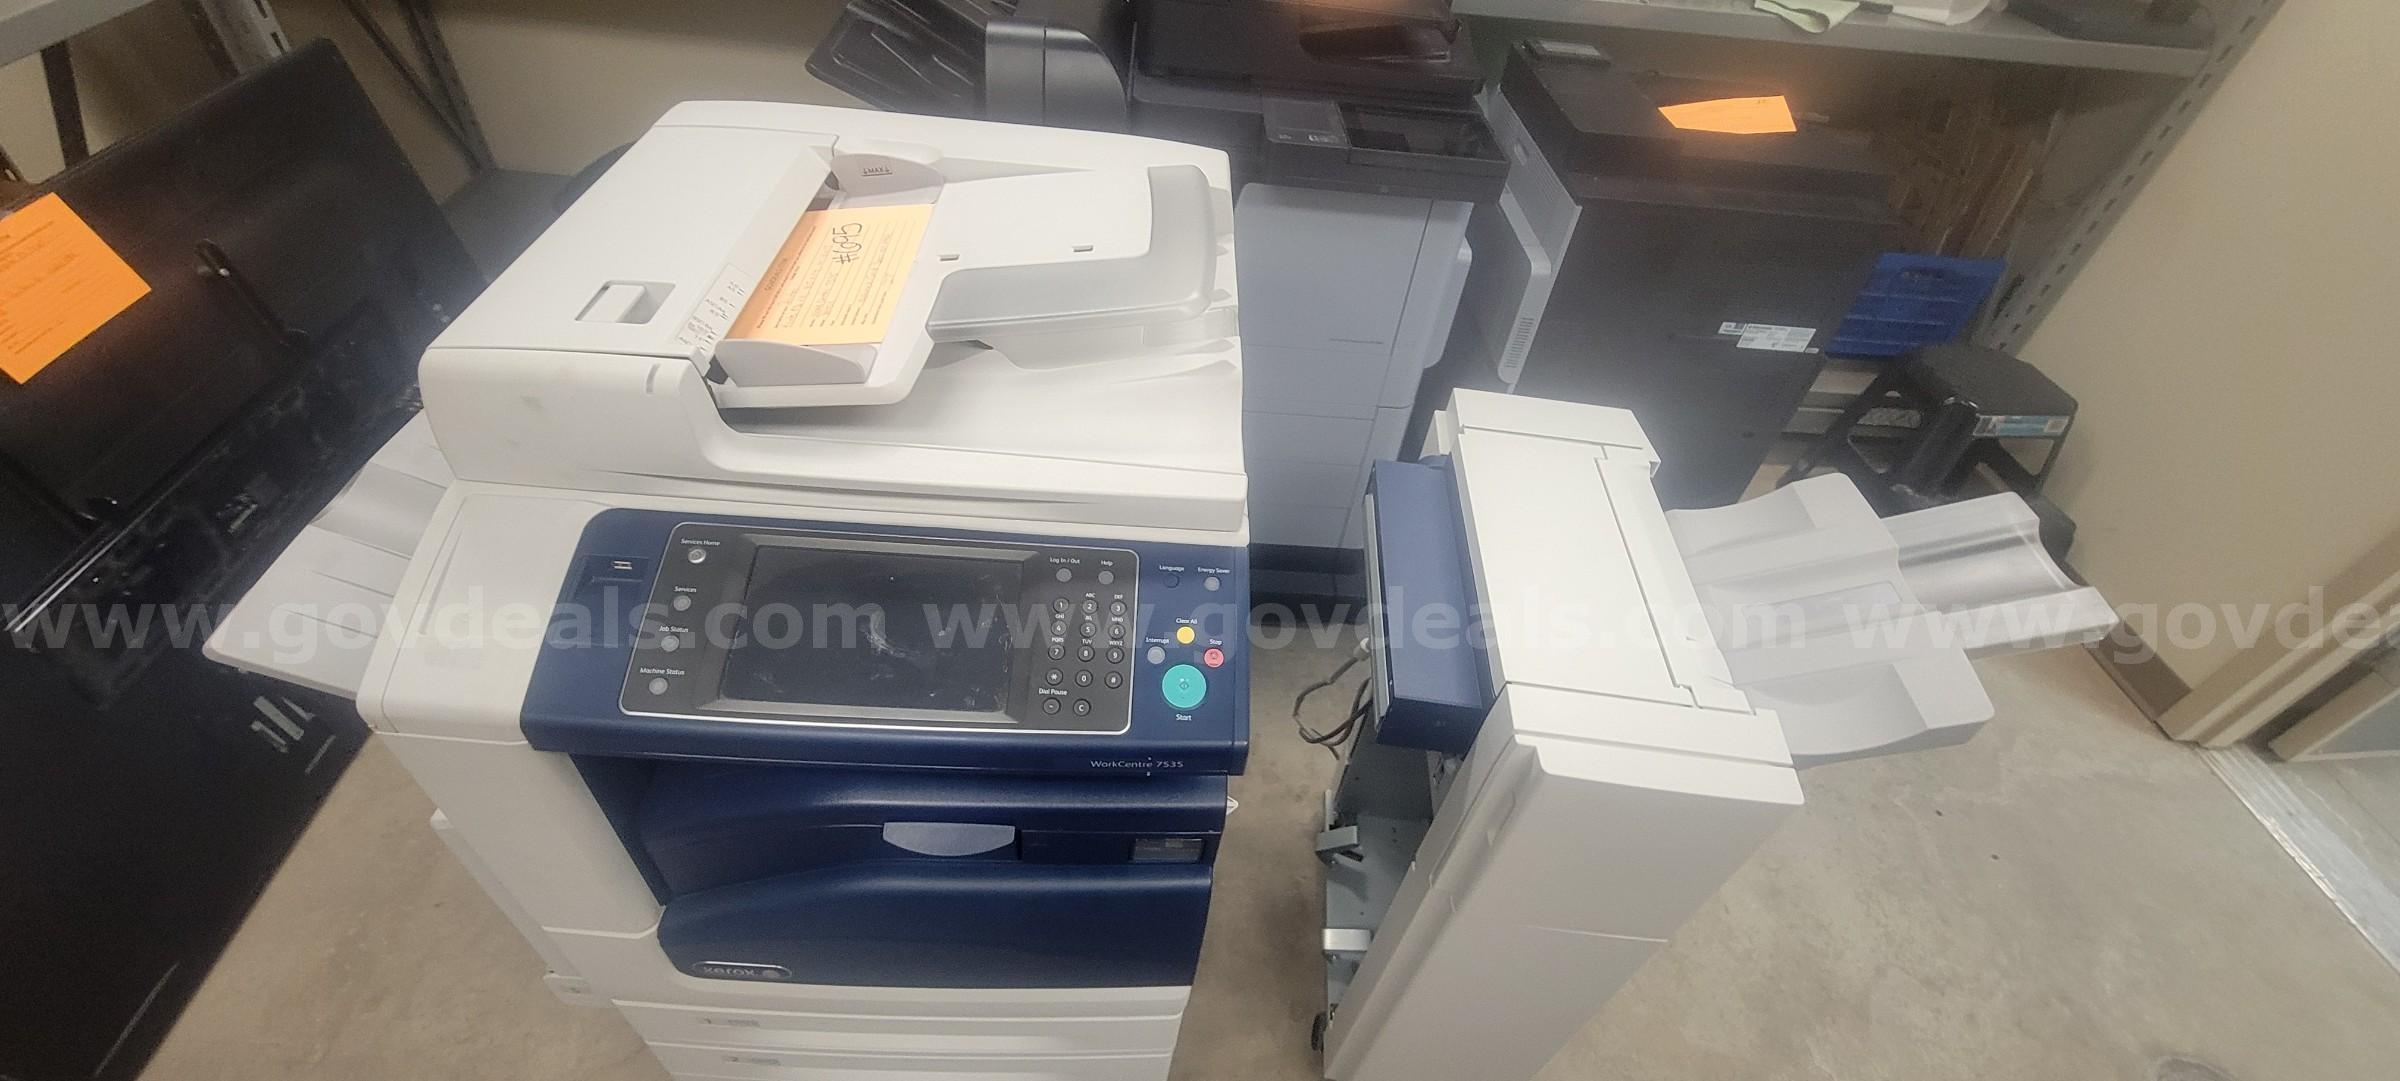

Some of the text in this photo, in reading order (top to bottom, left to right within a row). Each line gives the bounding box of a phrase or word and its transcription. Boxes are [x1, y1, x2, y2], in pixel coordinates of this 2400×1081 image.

[832, 223, 862, 264] #695
[1049, 556, 1059, 564] Log
[1159, 564, 1184, 572] Language
[1209, 638, 1222, 646] Stop
[1038, 687, 1068, 696] Dial Pause
[1175, 713, 1192, 721] Start
[1090, 760, 1184, 768] WorkCentre 7535
[703, 966, 755, 976] xerox
